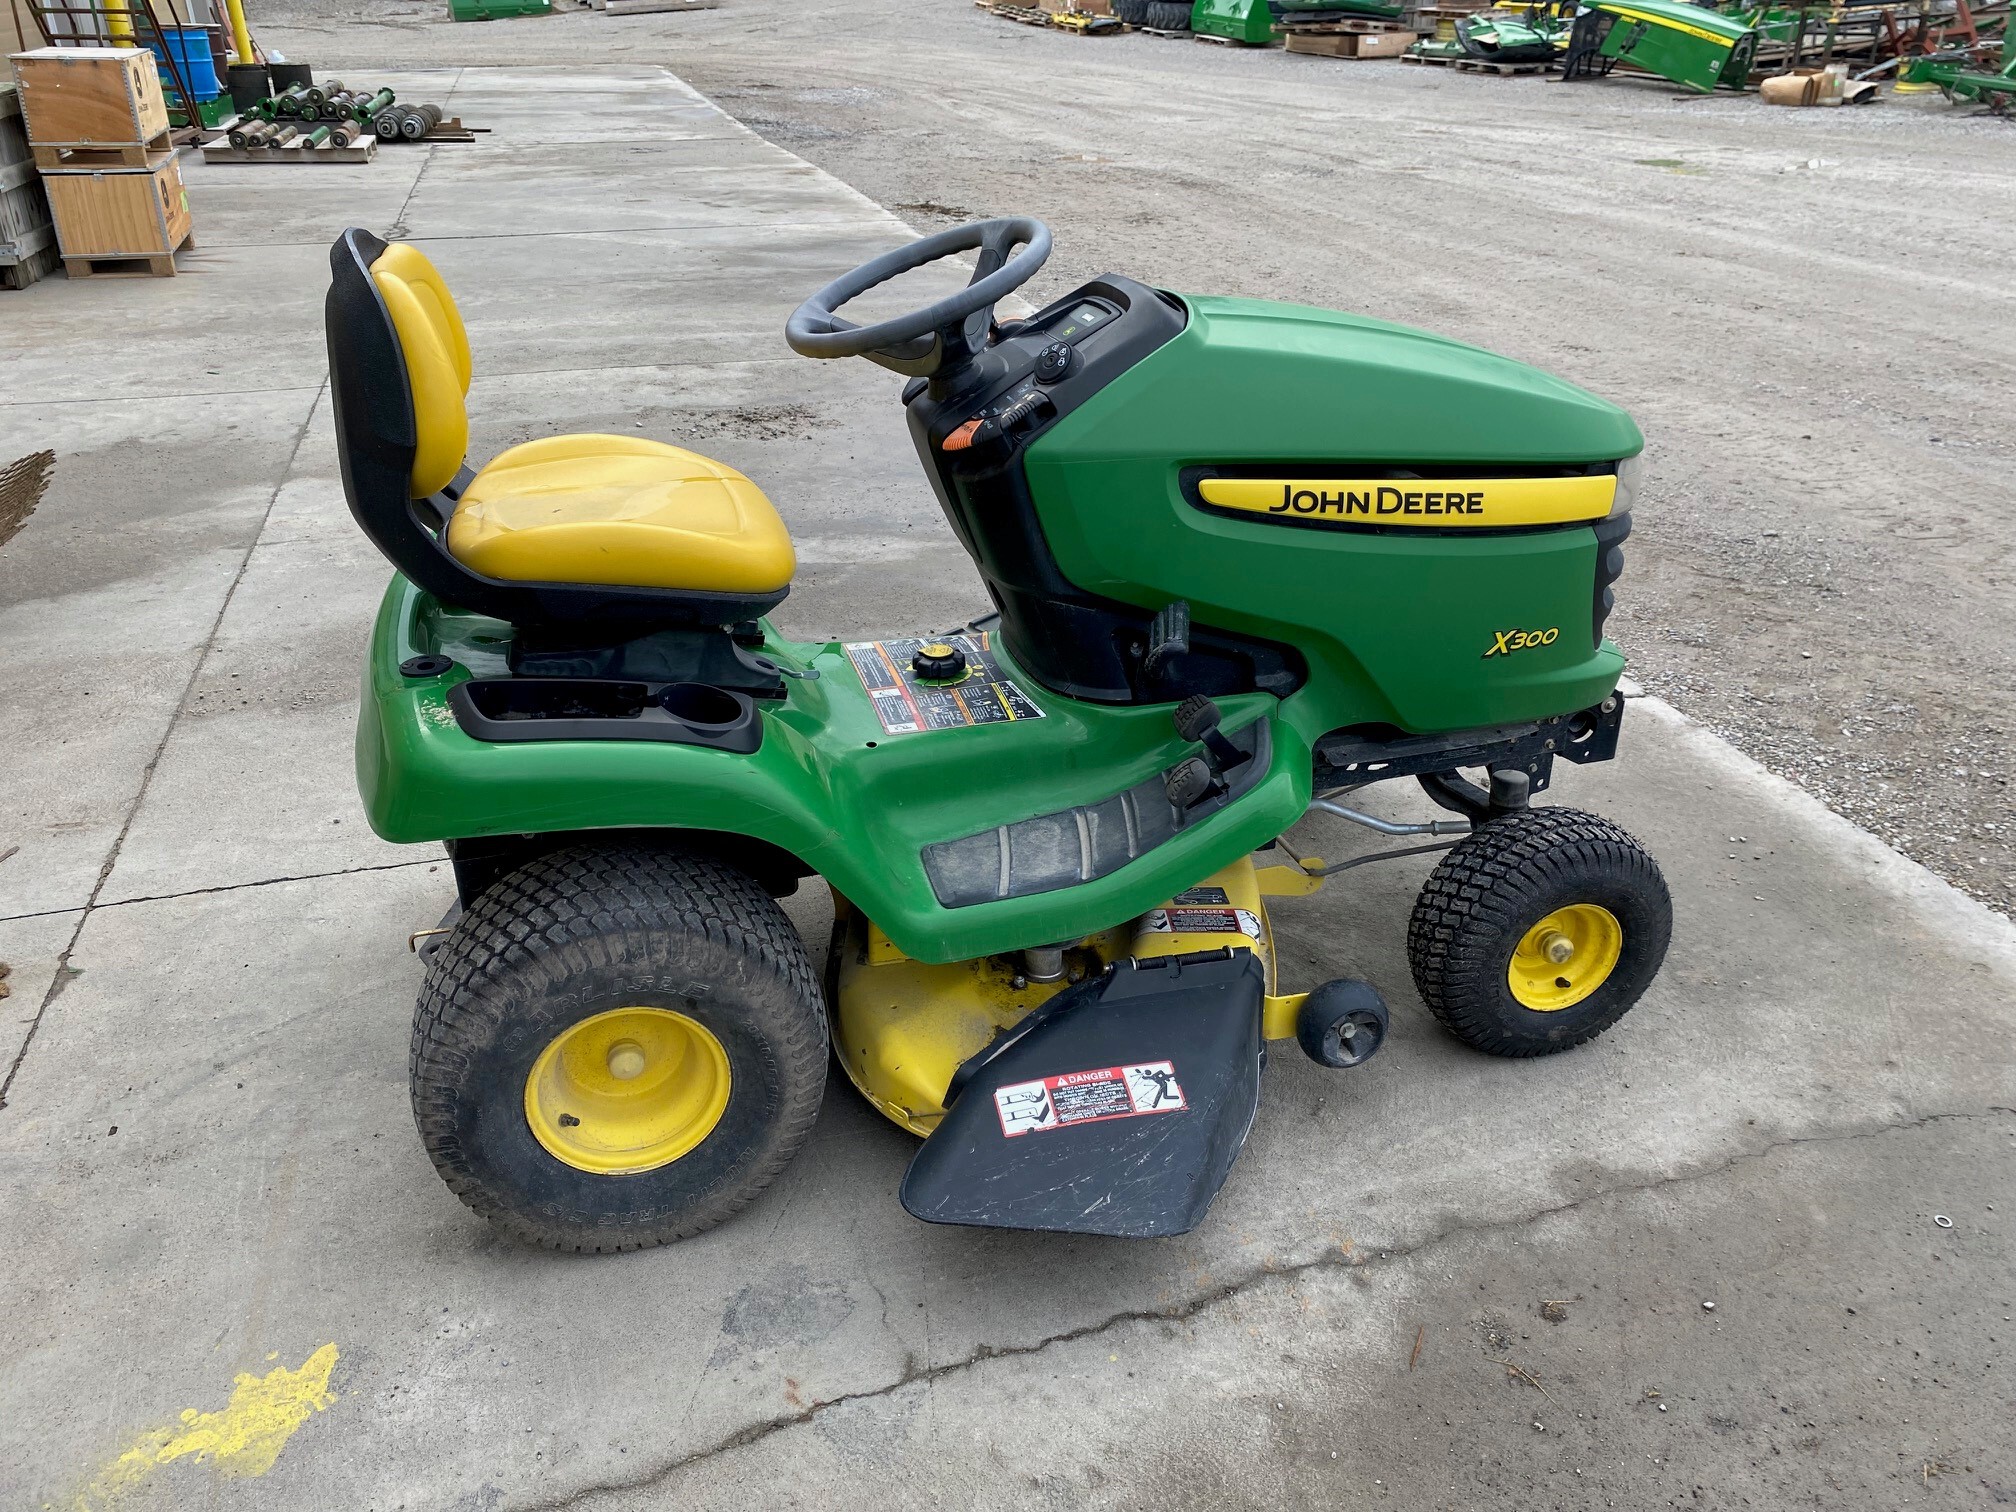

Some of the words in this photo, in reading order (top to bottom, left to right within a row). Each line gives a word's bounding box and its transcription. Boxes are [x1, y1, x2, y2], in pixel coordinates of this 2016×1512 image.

[1269, 484, 1370, 515] JOHN
[1376, 486, 1484, 515] DEERE
[1482, 627, 1560, 658] X300
[1068, 1070, 1113, 1084] DANGER
